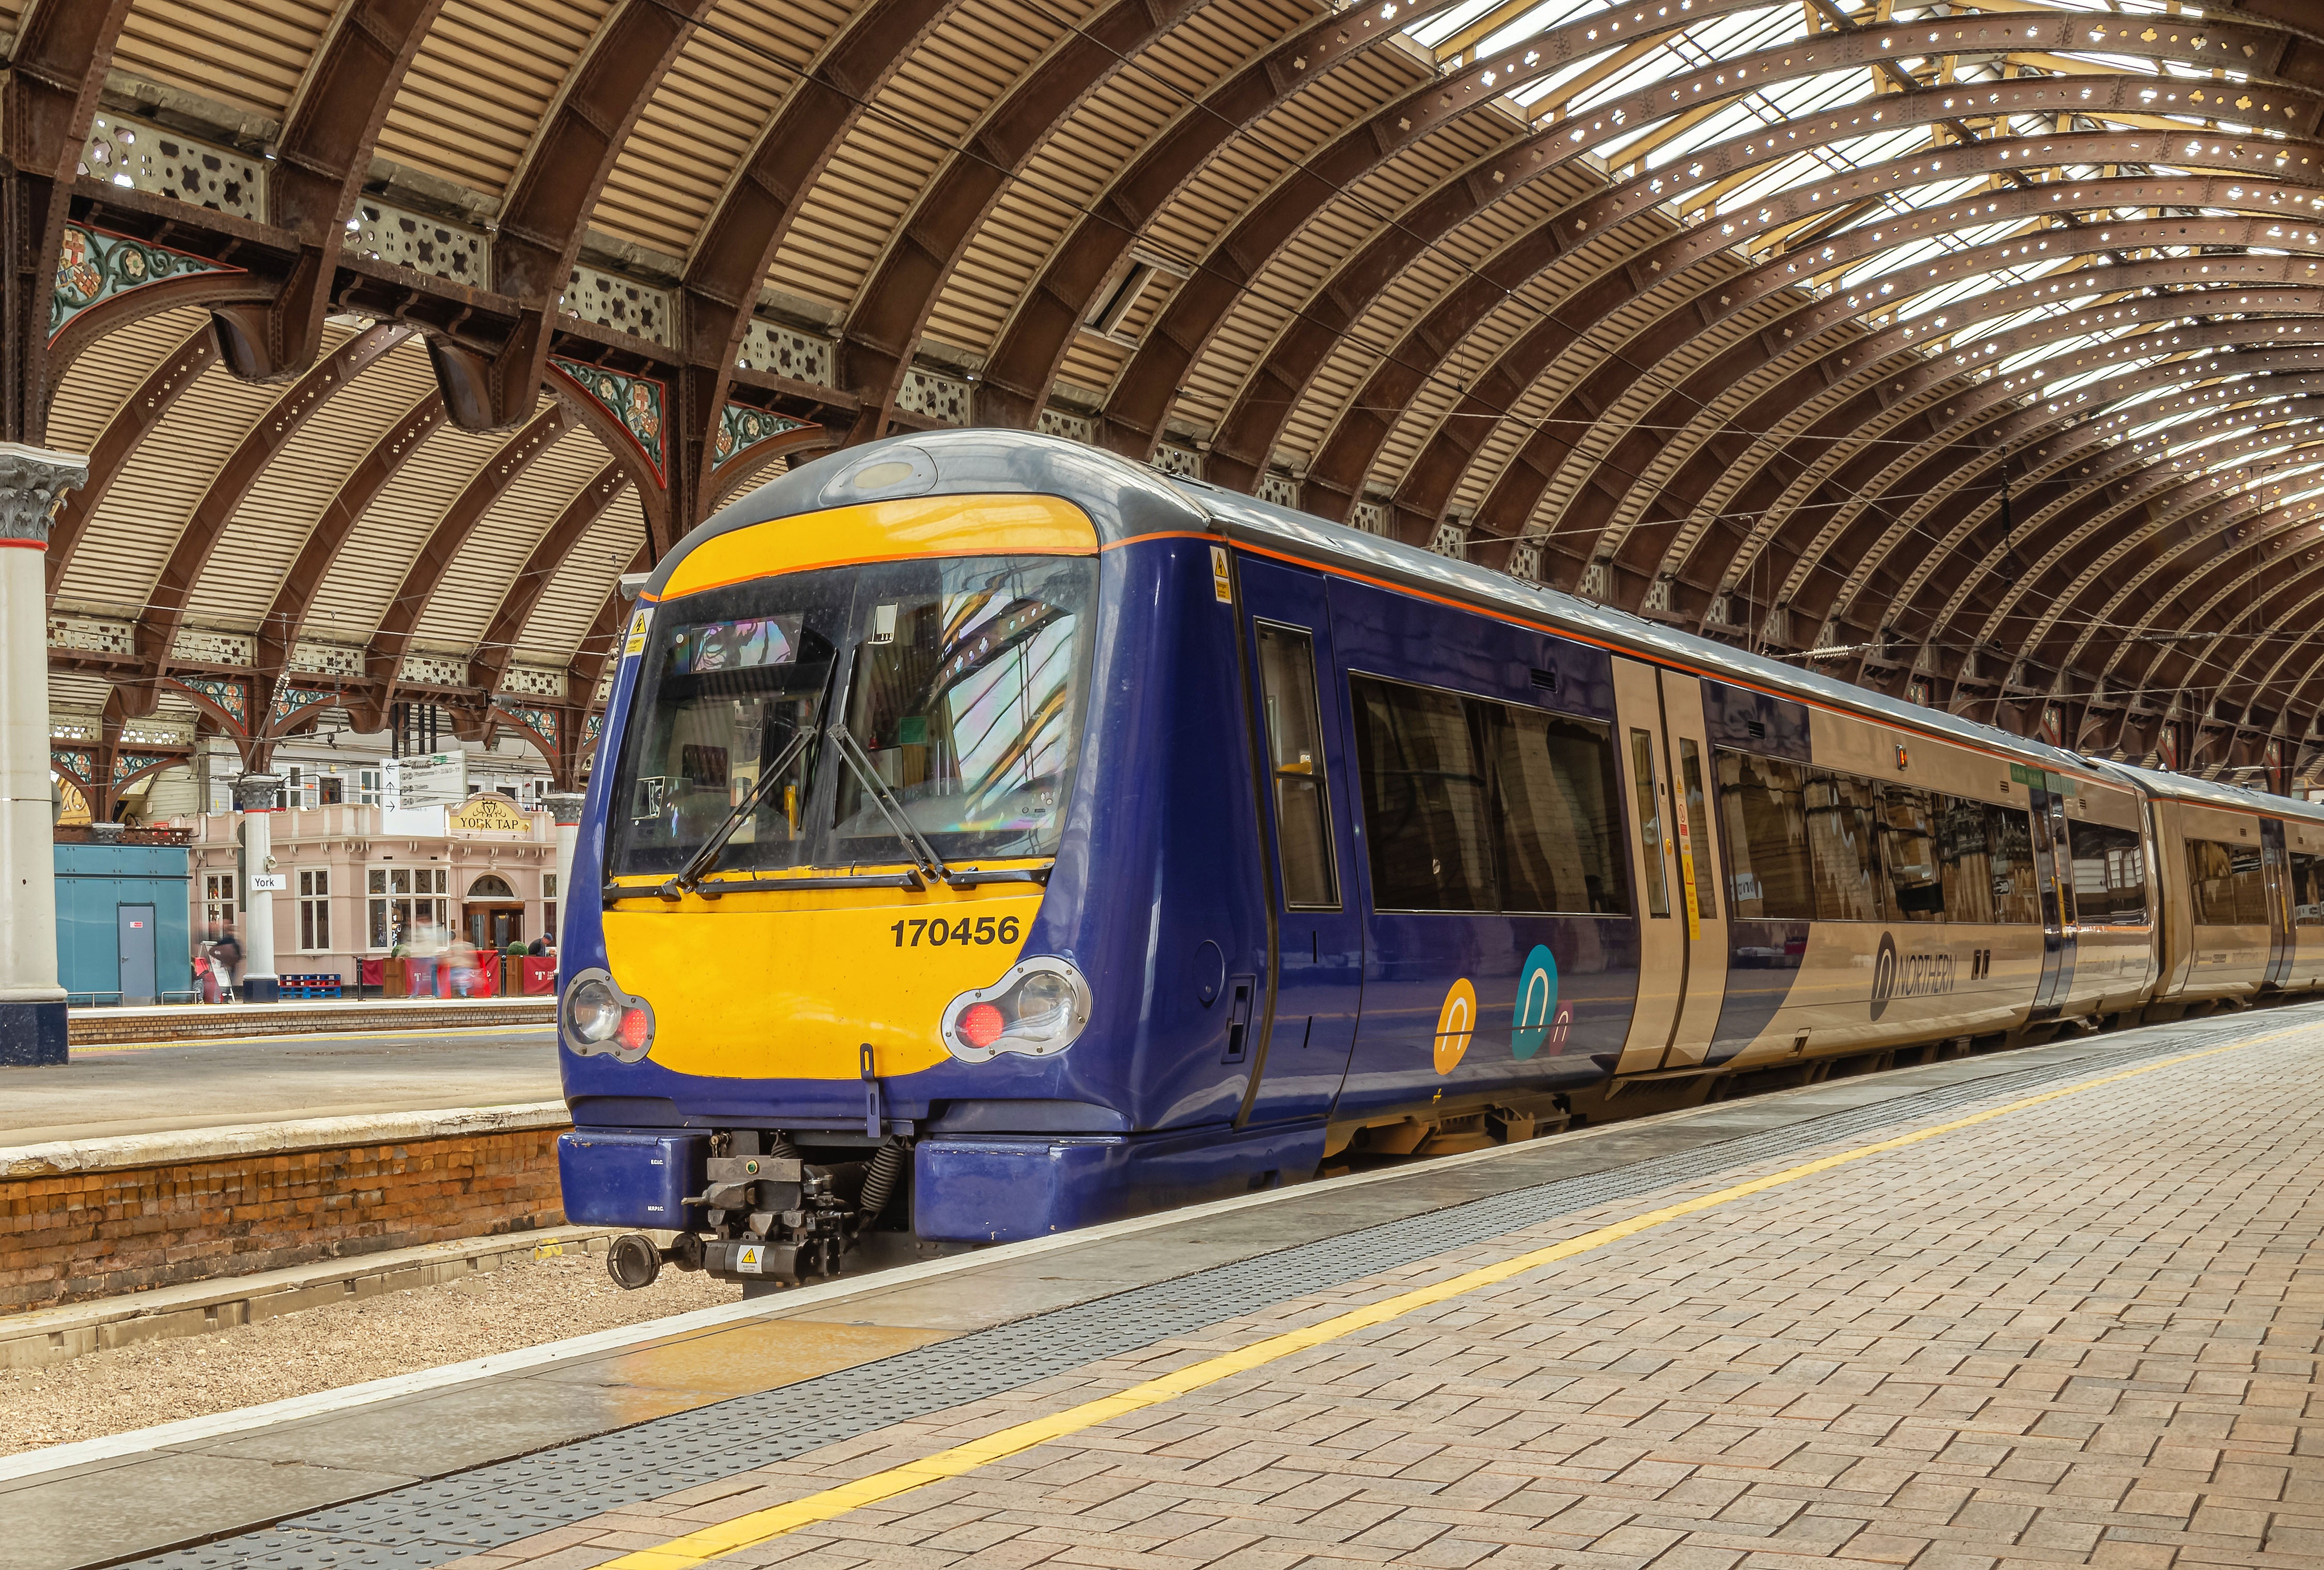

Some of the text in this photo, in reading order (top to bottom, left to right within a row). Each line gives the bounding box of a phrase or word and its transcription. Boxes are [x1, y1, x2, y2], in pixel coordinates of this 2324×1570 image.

[496, 819, 518, 829] TAP
[255, 878, 274, 887] York
[891, 916, 1019, 947] 170456
[1895, 954, 1957, 996] NORTHERN
